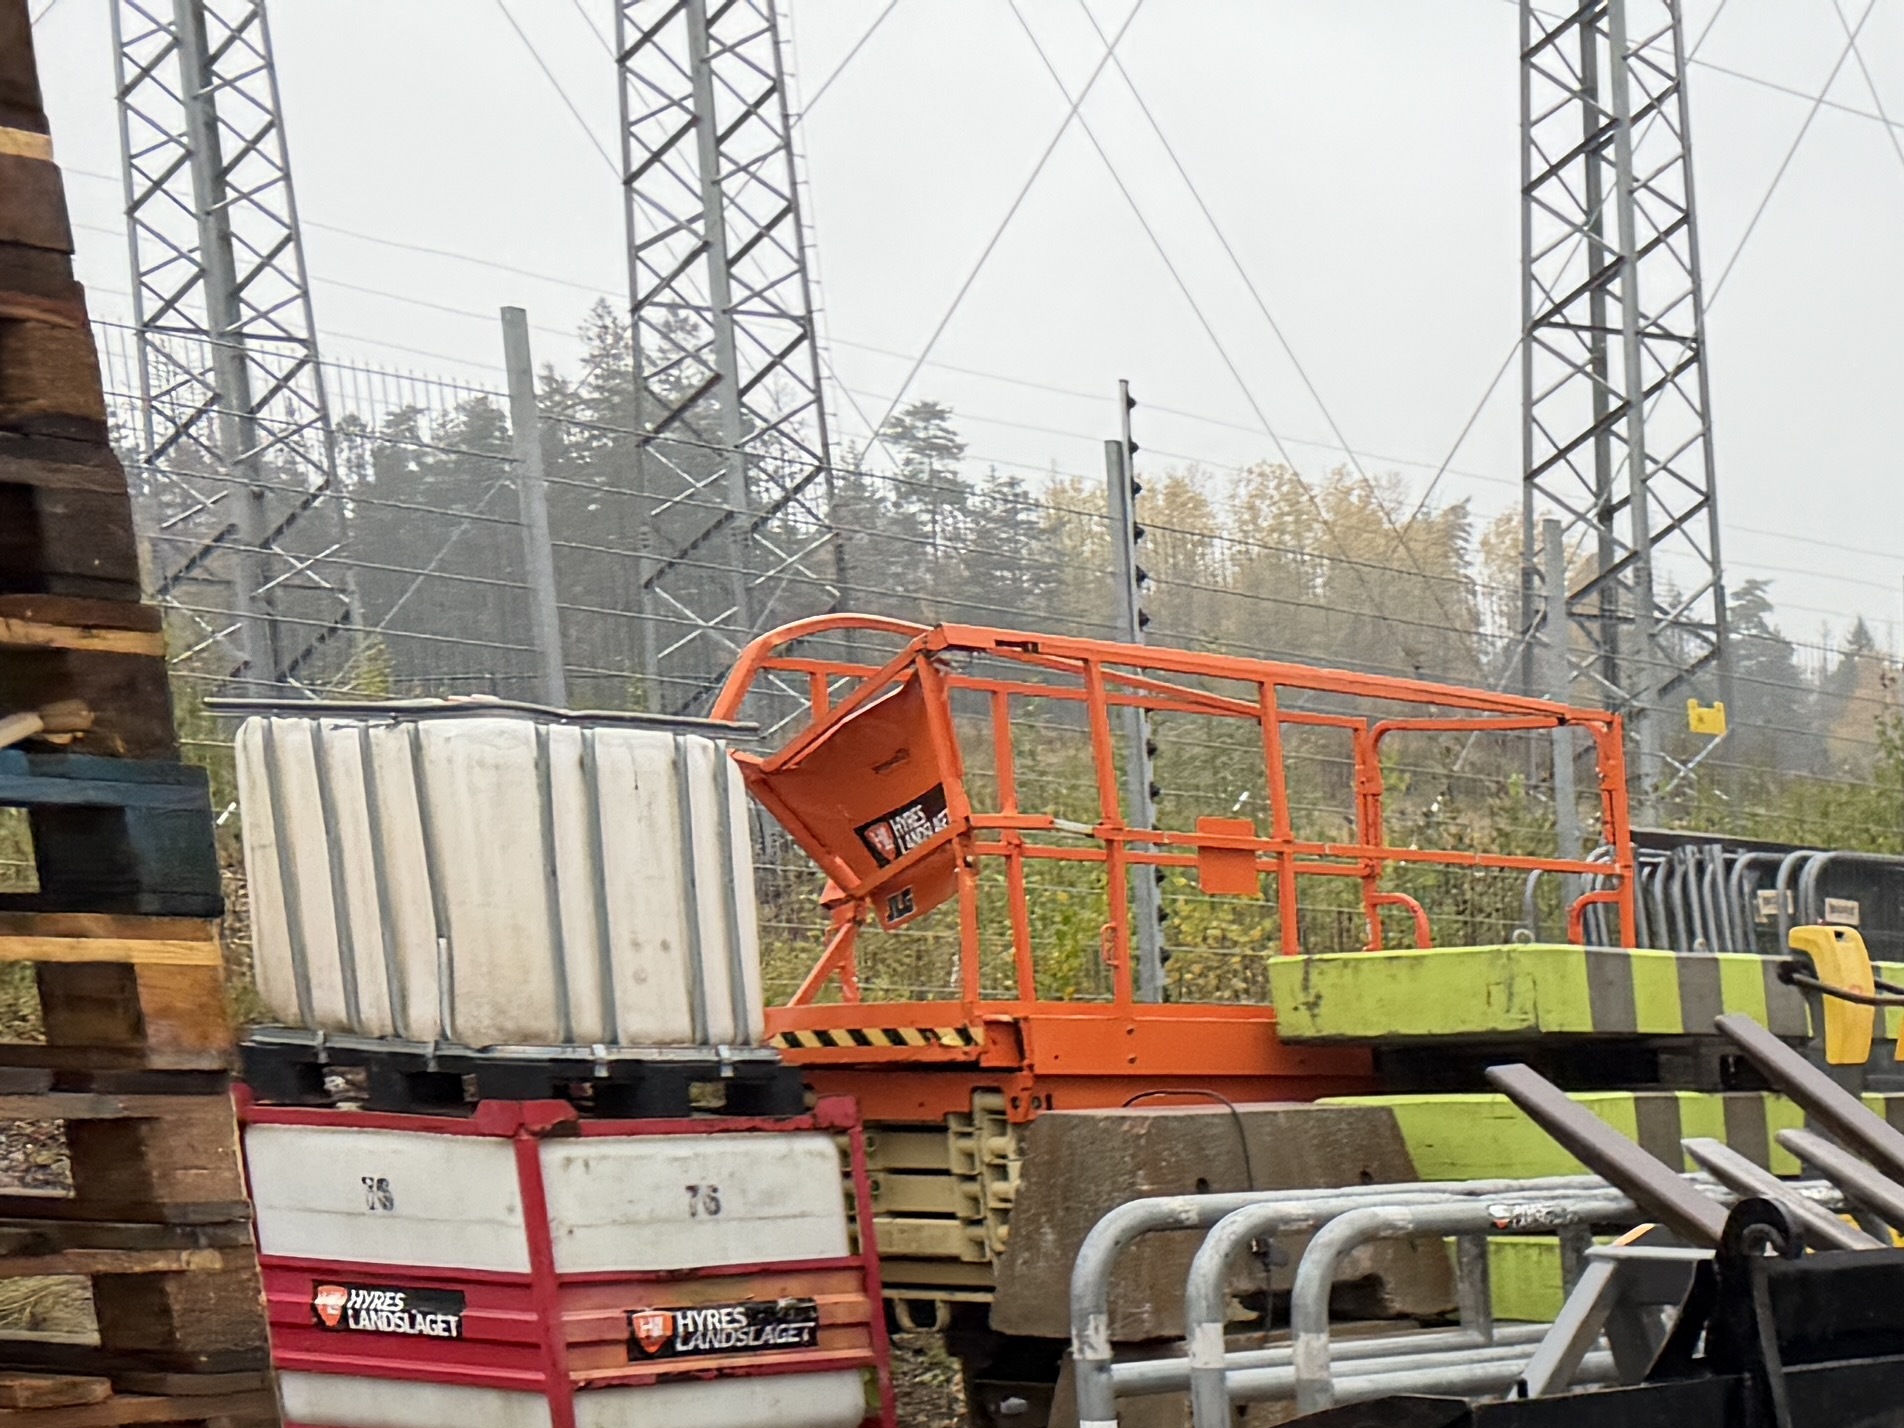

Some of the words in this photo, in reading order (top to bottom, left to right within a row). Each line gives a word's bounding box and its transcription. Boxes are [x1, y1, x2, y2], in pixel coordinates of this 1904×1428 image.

[685, 1184, 722, 1217] 76
[346, 1289, 407, 1312] HYRES
[347, 1309, 460, 1338] LANDSLAGET
[676, 1307, 749, 1333] HYRES
[675, 1321, 816, 1352] LANDSLAGET
